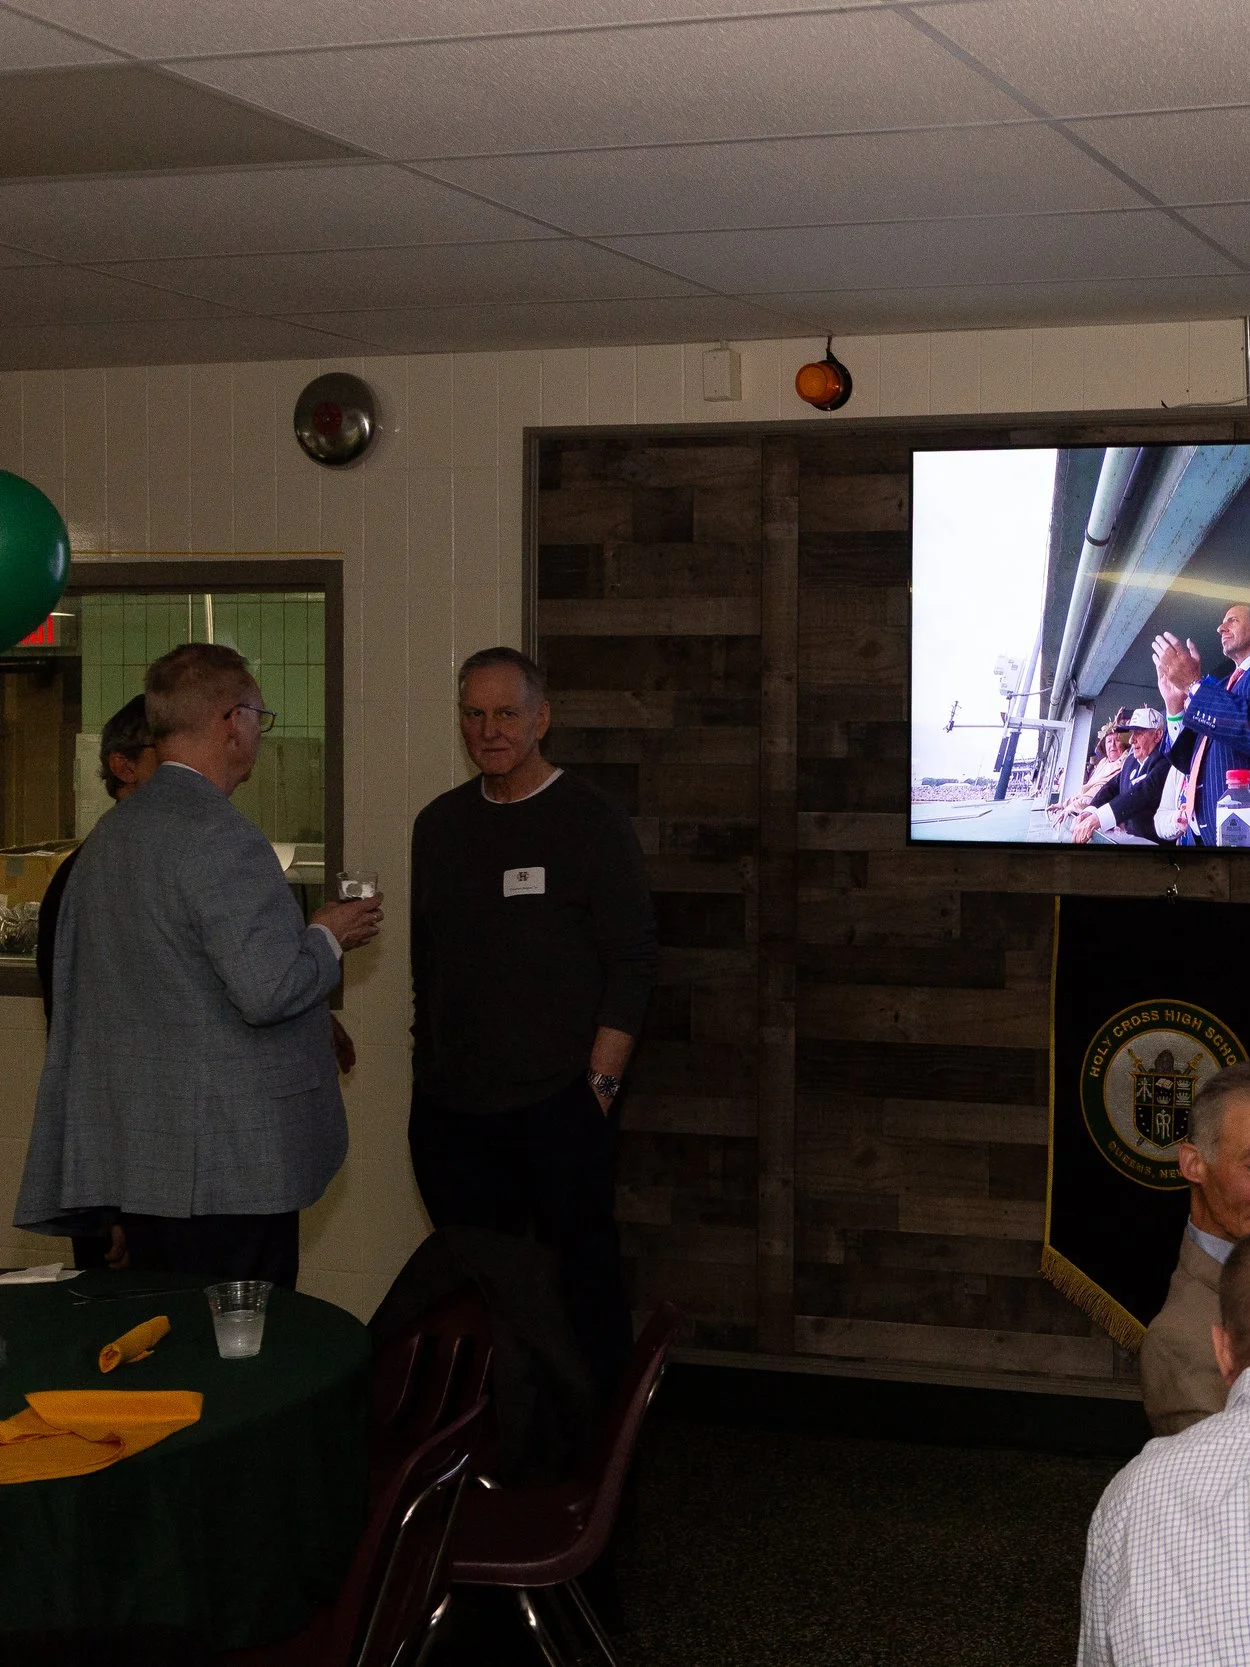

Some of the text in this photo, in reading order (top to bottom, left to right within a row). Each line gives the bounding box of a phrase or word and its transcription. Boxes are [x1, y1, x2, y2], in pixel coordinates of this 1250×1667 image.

[1089, 1009, 1238, 1078] HOLY CROSS HIGH SCHO
